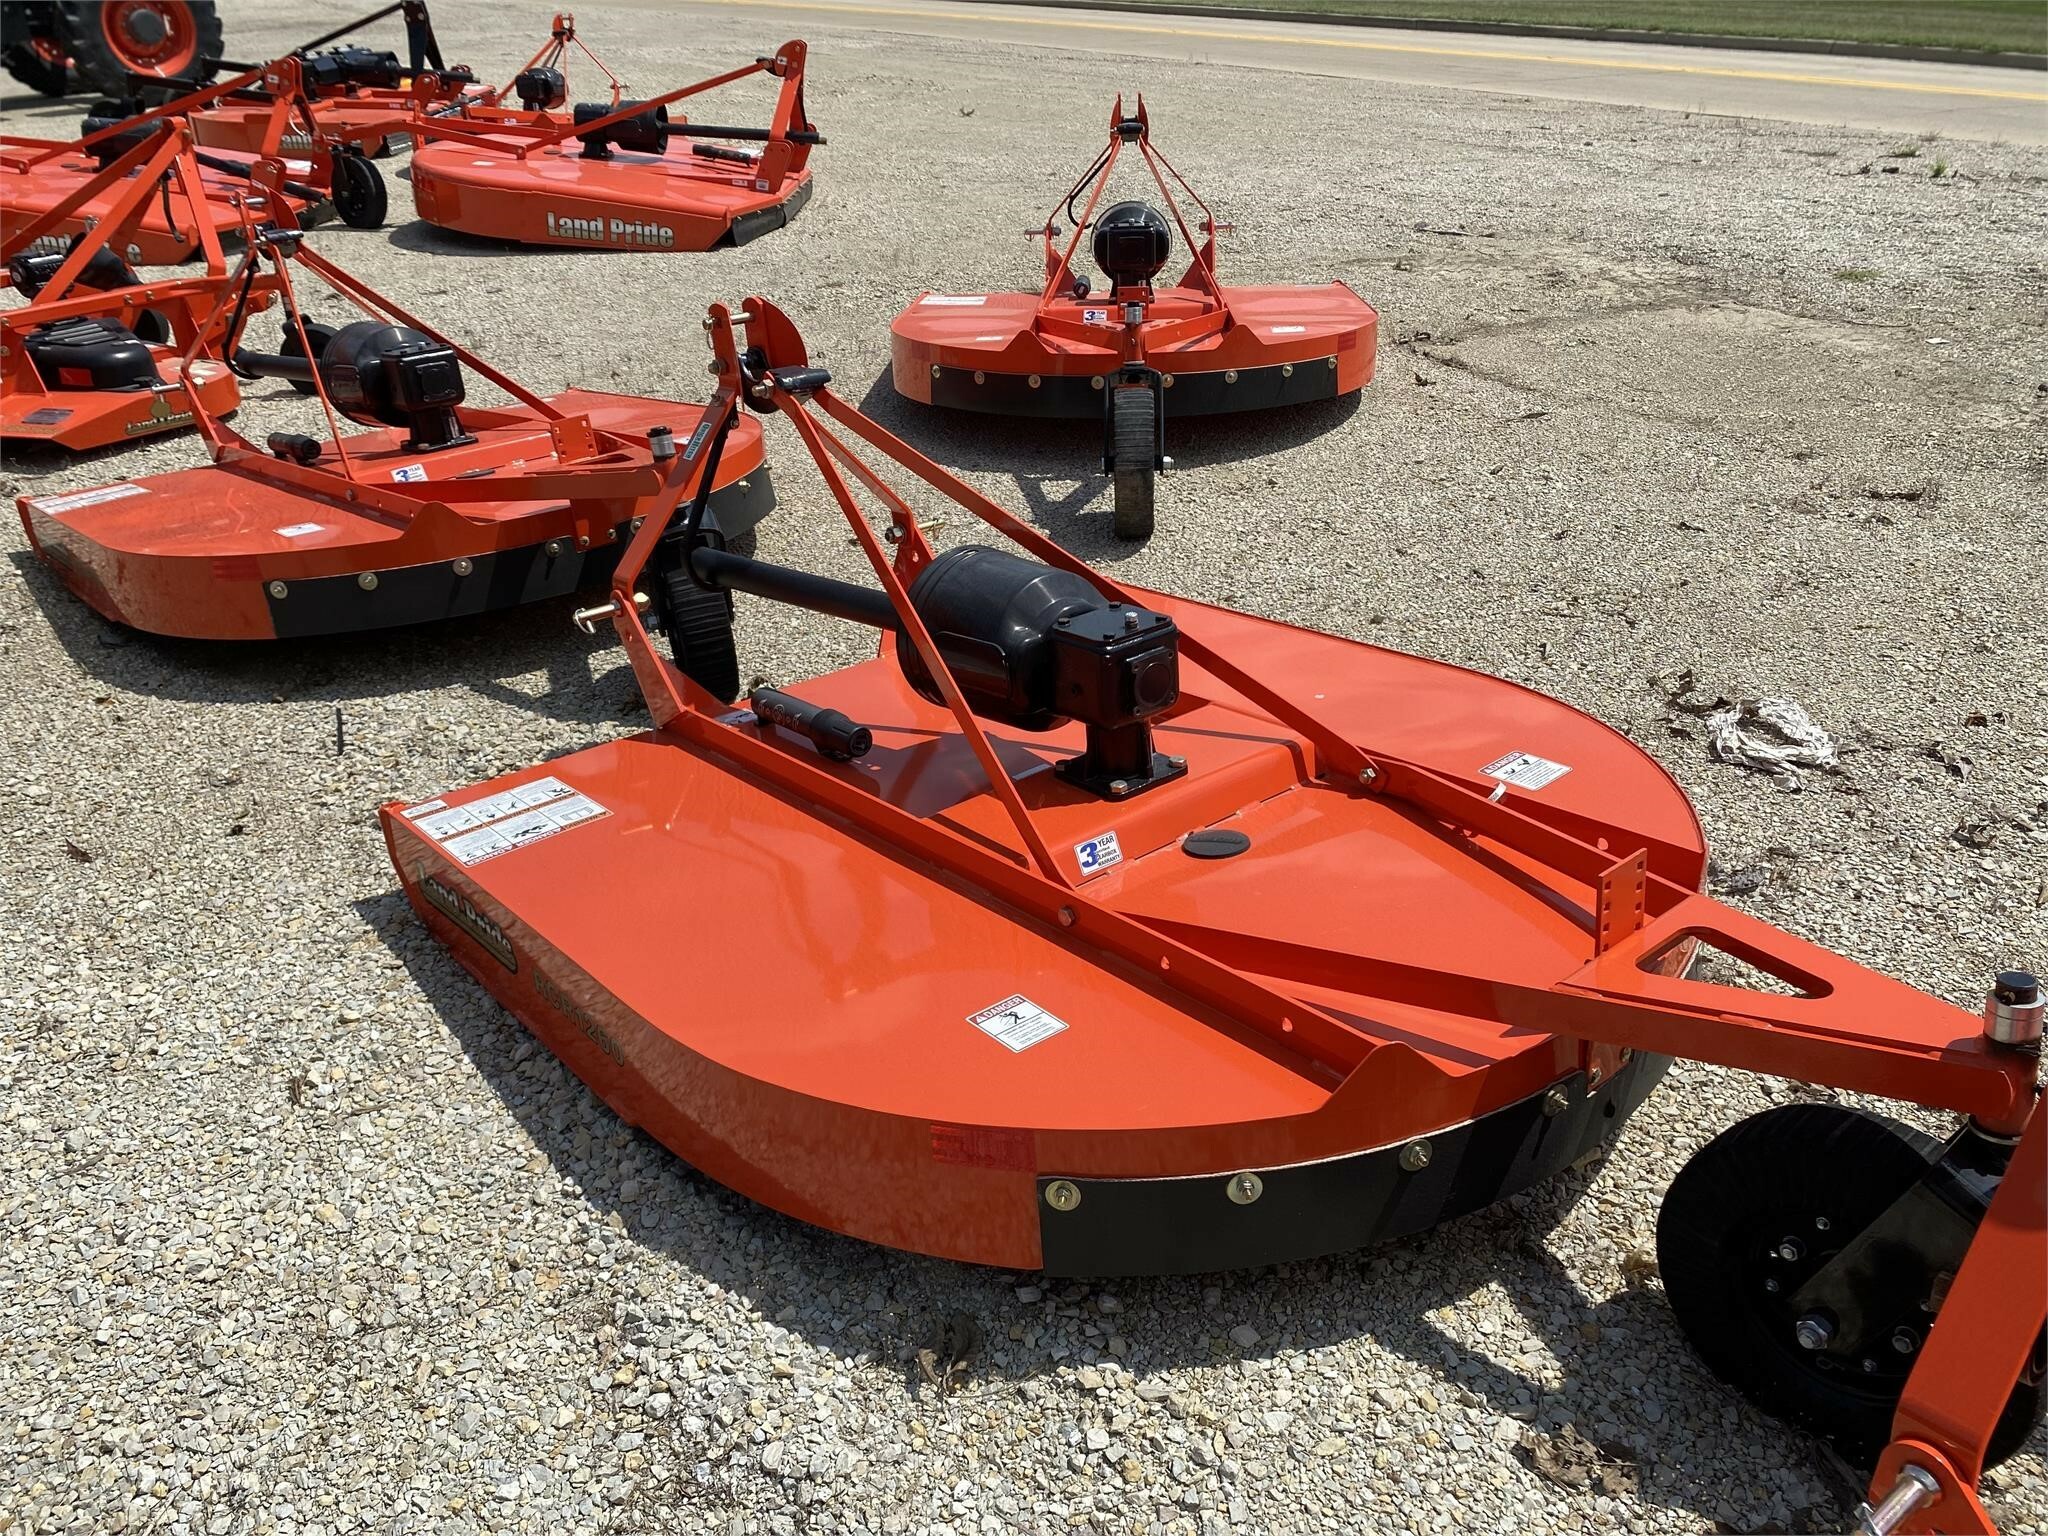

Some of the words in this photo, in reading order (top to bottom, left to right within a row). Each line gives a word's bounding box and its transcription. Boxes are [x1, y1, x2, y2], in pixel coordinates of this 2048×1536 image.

[546, 211, 604, 241] Land
[609, 218, 675, 248] Pride
[1097, 834, 1115, 848] YEAR
[1079, 841, 1100, 868] 3
[984, 996, 1025, 1019] DANGER
